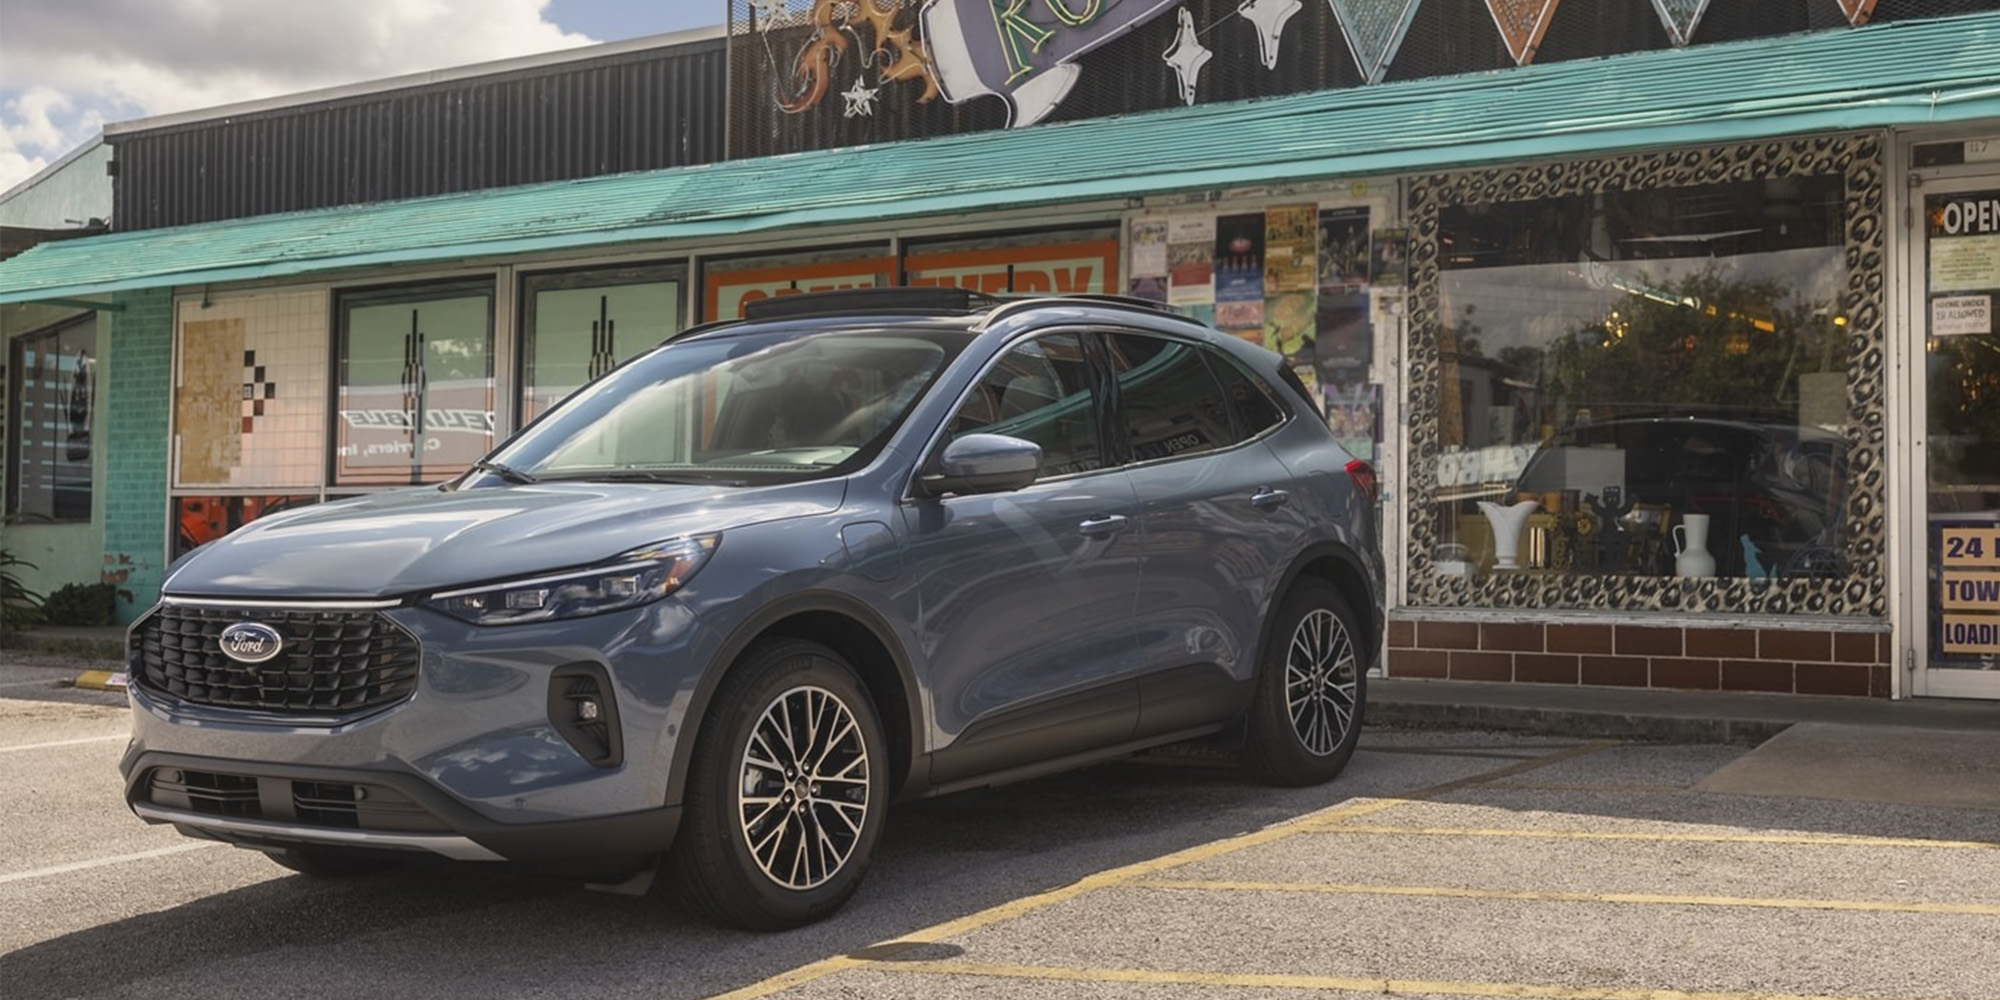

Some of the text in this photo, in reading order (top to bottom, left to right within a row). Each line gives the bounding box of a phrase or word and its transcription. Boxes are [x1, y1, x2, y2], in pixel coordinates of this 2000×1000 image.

[1947, 308, 1985, 319] ALLOWED
[1946, 537, 1983, 558] 24
[1946, 580, 2000, 602] TOW
[231, 630, 265, 653] Ford
